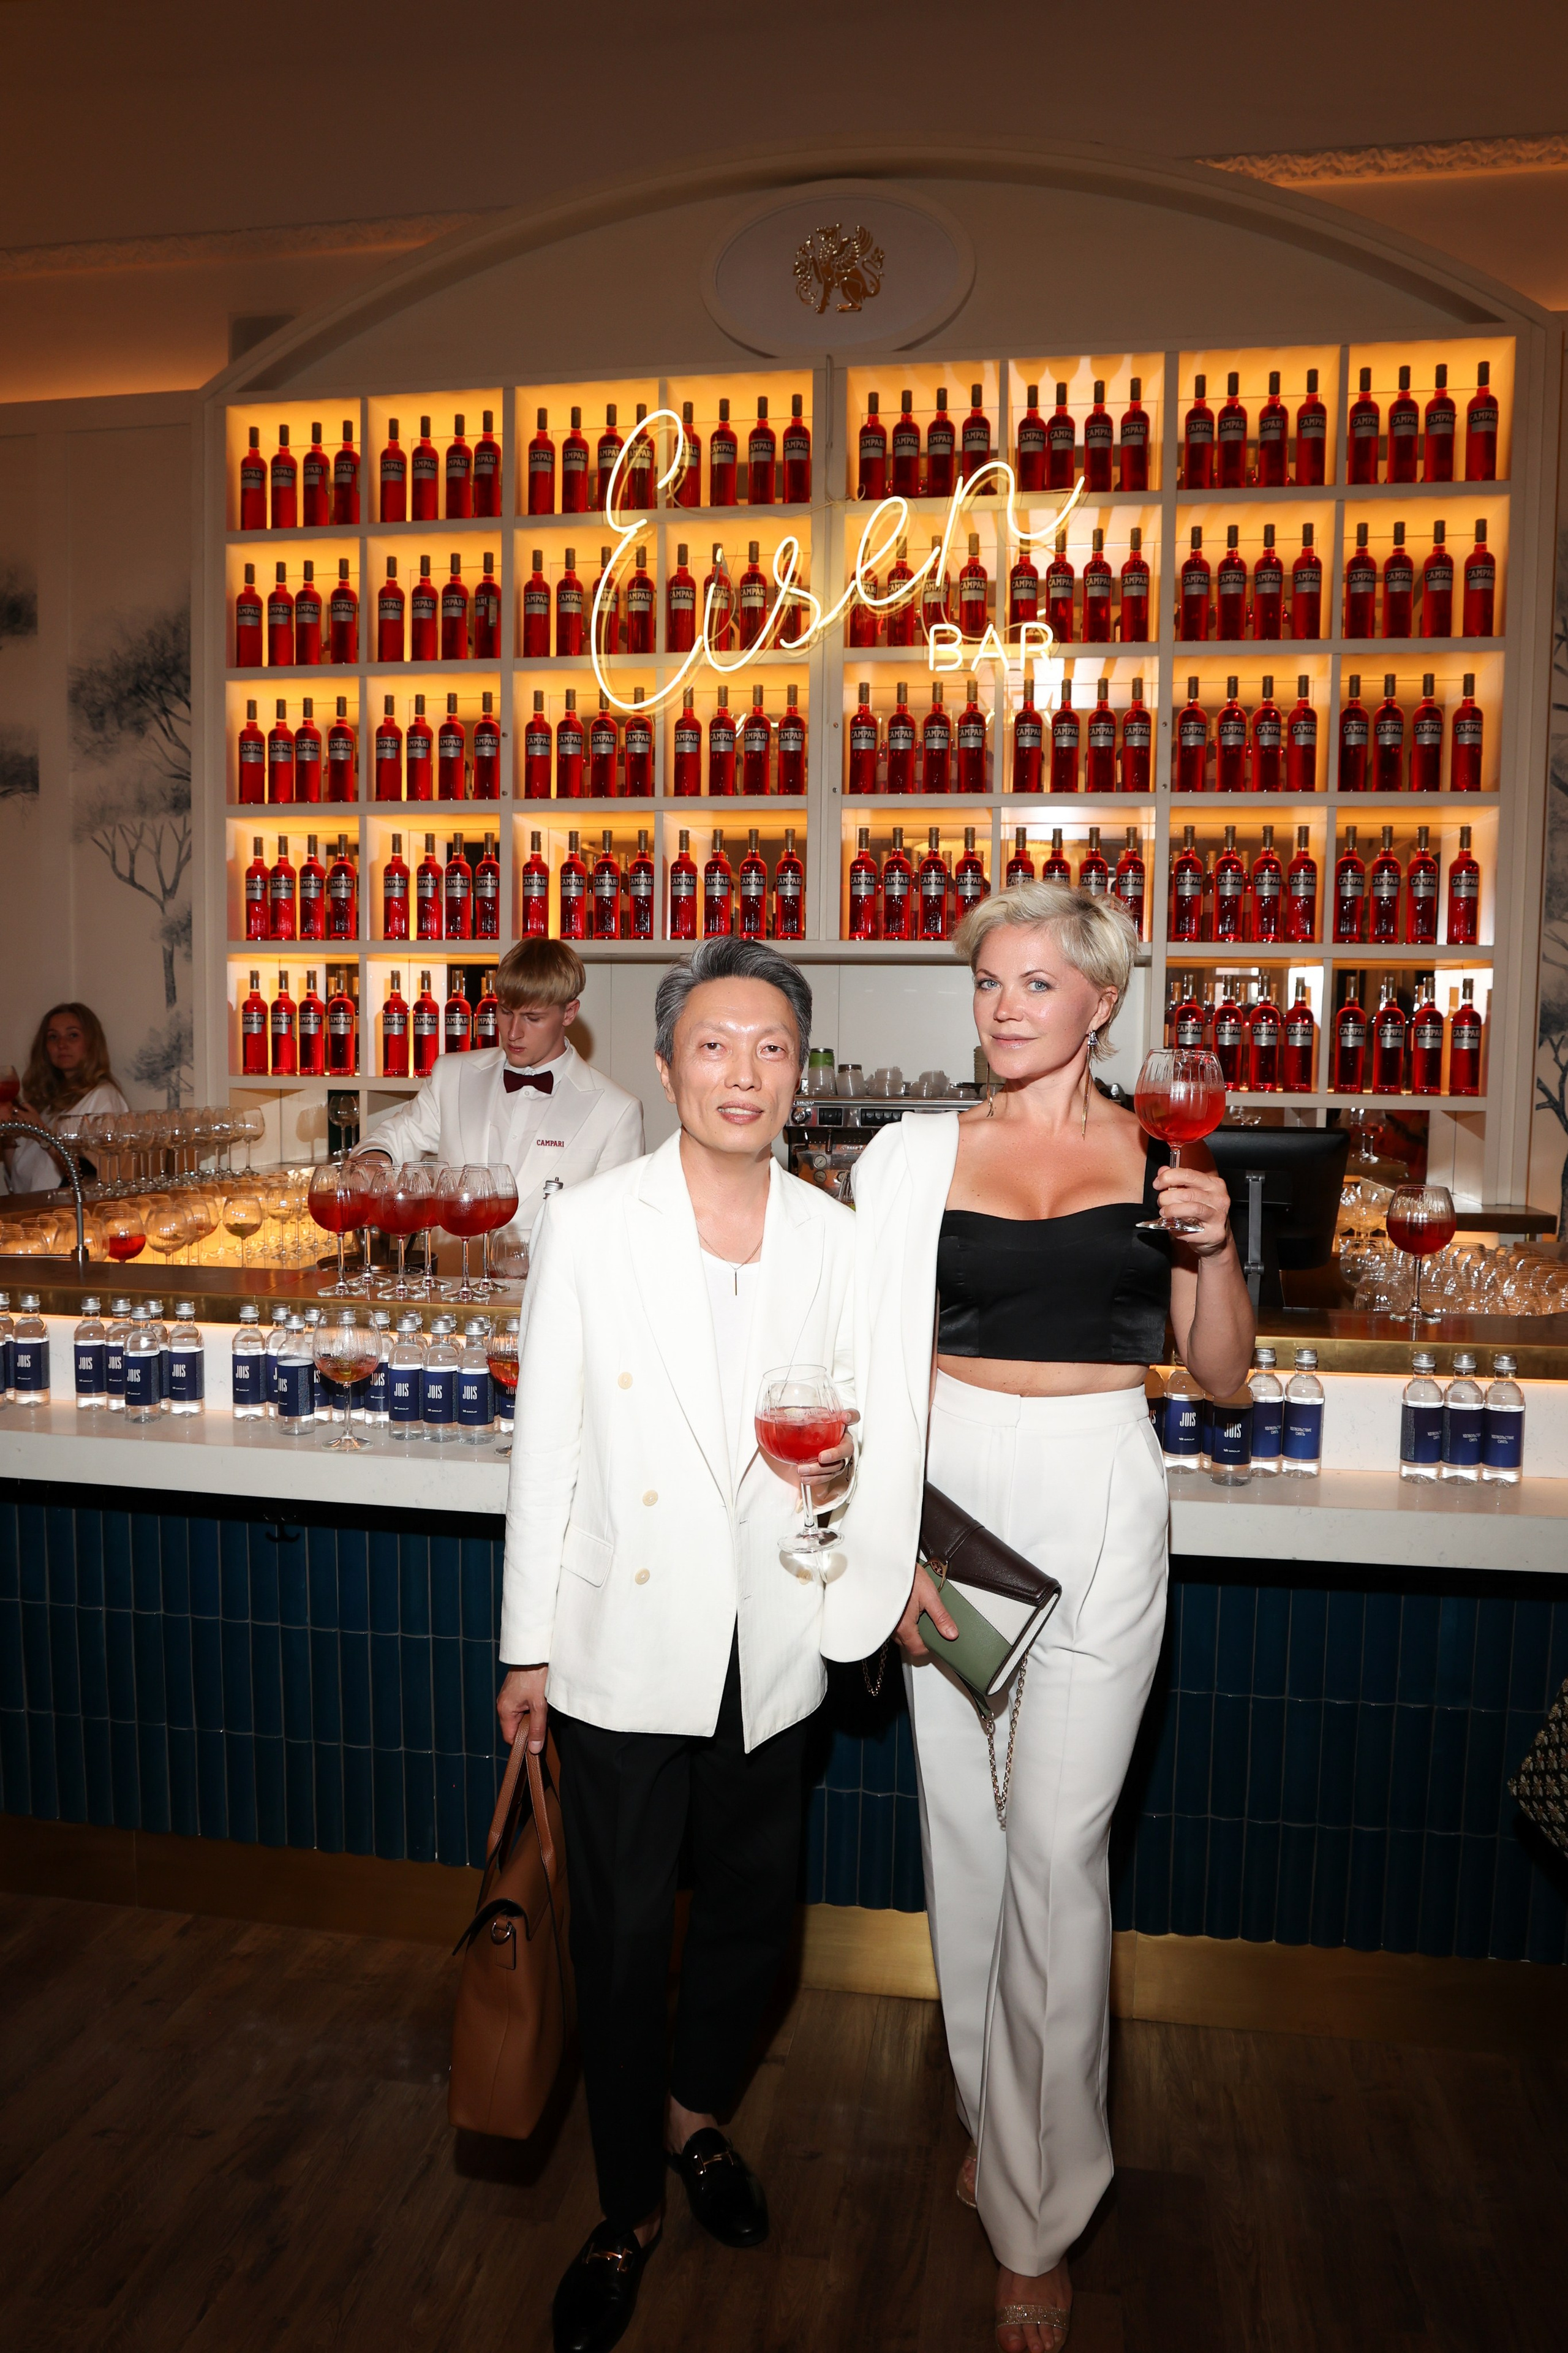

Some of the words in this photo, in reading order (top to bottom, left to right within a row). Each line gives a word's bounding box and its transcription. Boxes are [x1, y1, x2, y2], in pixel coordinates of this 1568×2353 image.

[442, 599, 464, 607] AMPARI
[929, 621, 1055, 673] BAR
[440, 738, 462, 746] AMPARI
[475, 737, 498, 746] AMPARI
[300, 879, 322, 888] AMPARI
[17, 1354, 31, 1367] JOIS
[78, 1357, 92, 1370] JOIS
[108, 1356, 121, 1370] JOIS
[127, 1369, 141, 1383] JOIS
[172, 1364, 186, 1378] JOIS
[236, 1365, 249, 1379] JOIS
[278, 1378, 287, 1392] OIS
[370, 1373, 385, 1386] JOIS
[394, 1383, 409, 1397] JOIS
[428, 1385, 442, 1399] JOIS
[462, 1386, 477, 1400] JOIS
[1180, 1412, 1196, 1427] JOIS
[1224, 1423, 1242, 1438] JOIS
